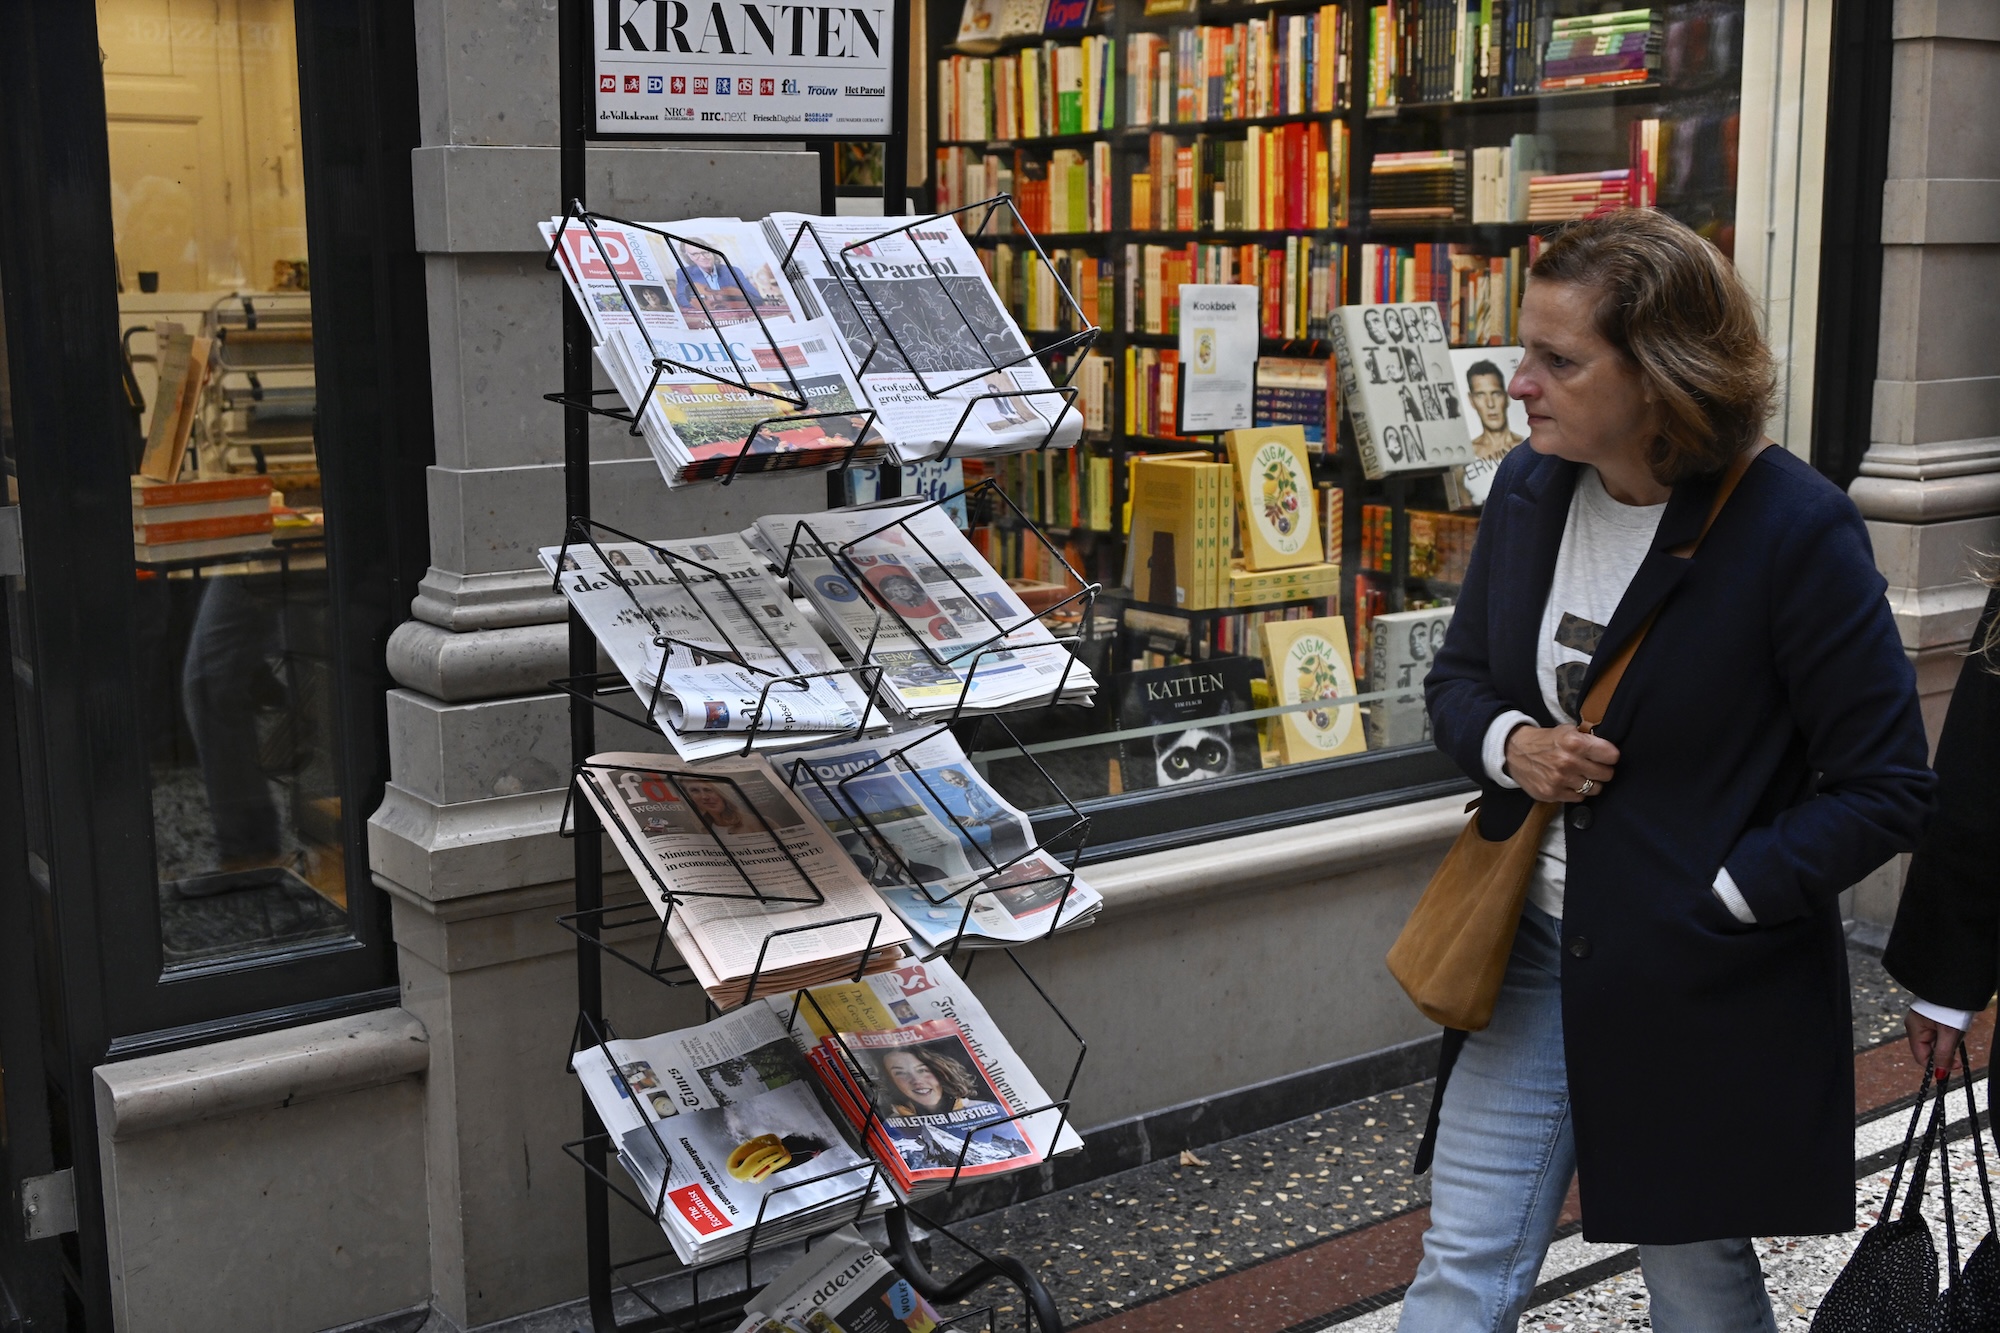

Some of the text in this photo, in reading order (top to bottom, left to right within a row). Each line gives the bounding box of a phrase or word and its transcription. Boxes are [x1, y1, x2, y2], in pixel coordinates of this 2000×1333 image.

[605, 0, 884, 58] KRANTEN
[600, 77, 615, 90] AD
[649, 77, 663, 91] ED
[694, 78, 708, 89] BN
[807, 85, 838, 96] Trouw
[844, 86, 886, 95] Het Parool
[664, 107, 687, 117] NRC
[580, 234, 630, 266] AD
[870, 257, 960, 279] Parool
[1193, 301, 1237, 311] Kookboek
[1363, 306, 1443, 345] CORB
[676, 342, 752, 362] DHC
[705, 364, 758, 374] Centaal
[662, 389, 723, 405] Nieuwe
[1398, 382, 1462, 422] ANT
[1383, 424, 1427, 464] ON
[1257, 445, 1294, 468] LUGMA
[1196, 478, 1204, 569] LUGMA
[1208, 477, 1216, 569] LUGMA
[1222, 476, 1230, 567] LUGMA
[1243, 572, 1312, 588] LUGMA
[1243, 588, 1312, 602] LUGMA
[876, 651, 917, 663] FENIX
[1291, 638, 1333, 661] LUGMA
[1146, 673, 1225, 701] KATTEN
[788, 758, 875, 783] Trouw
[618, 772, 681, 805] fd
[658, 849, 701, 862] Minister
[753, 845, 777, 856] meer
[665, 862, 679, 872] in
[809, 847, 825, 857] EU
[859, 1029, 925, 1047] SPIEGEL
[885, 1103, 999, 1129] IHR LETZTER AUFSTIEG
[678, 1136, 741, 1216] The coming debt emergency
[688, 1189, 723, 1228] Economist
[688, 1205, 703, 1222] The
[898, 1281, 911, 1314] WOLKE
